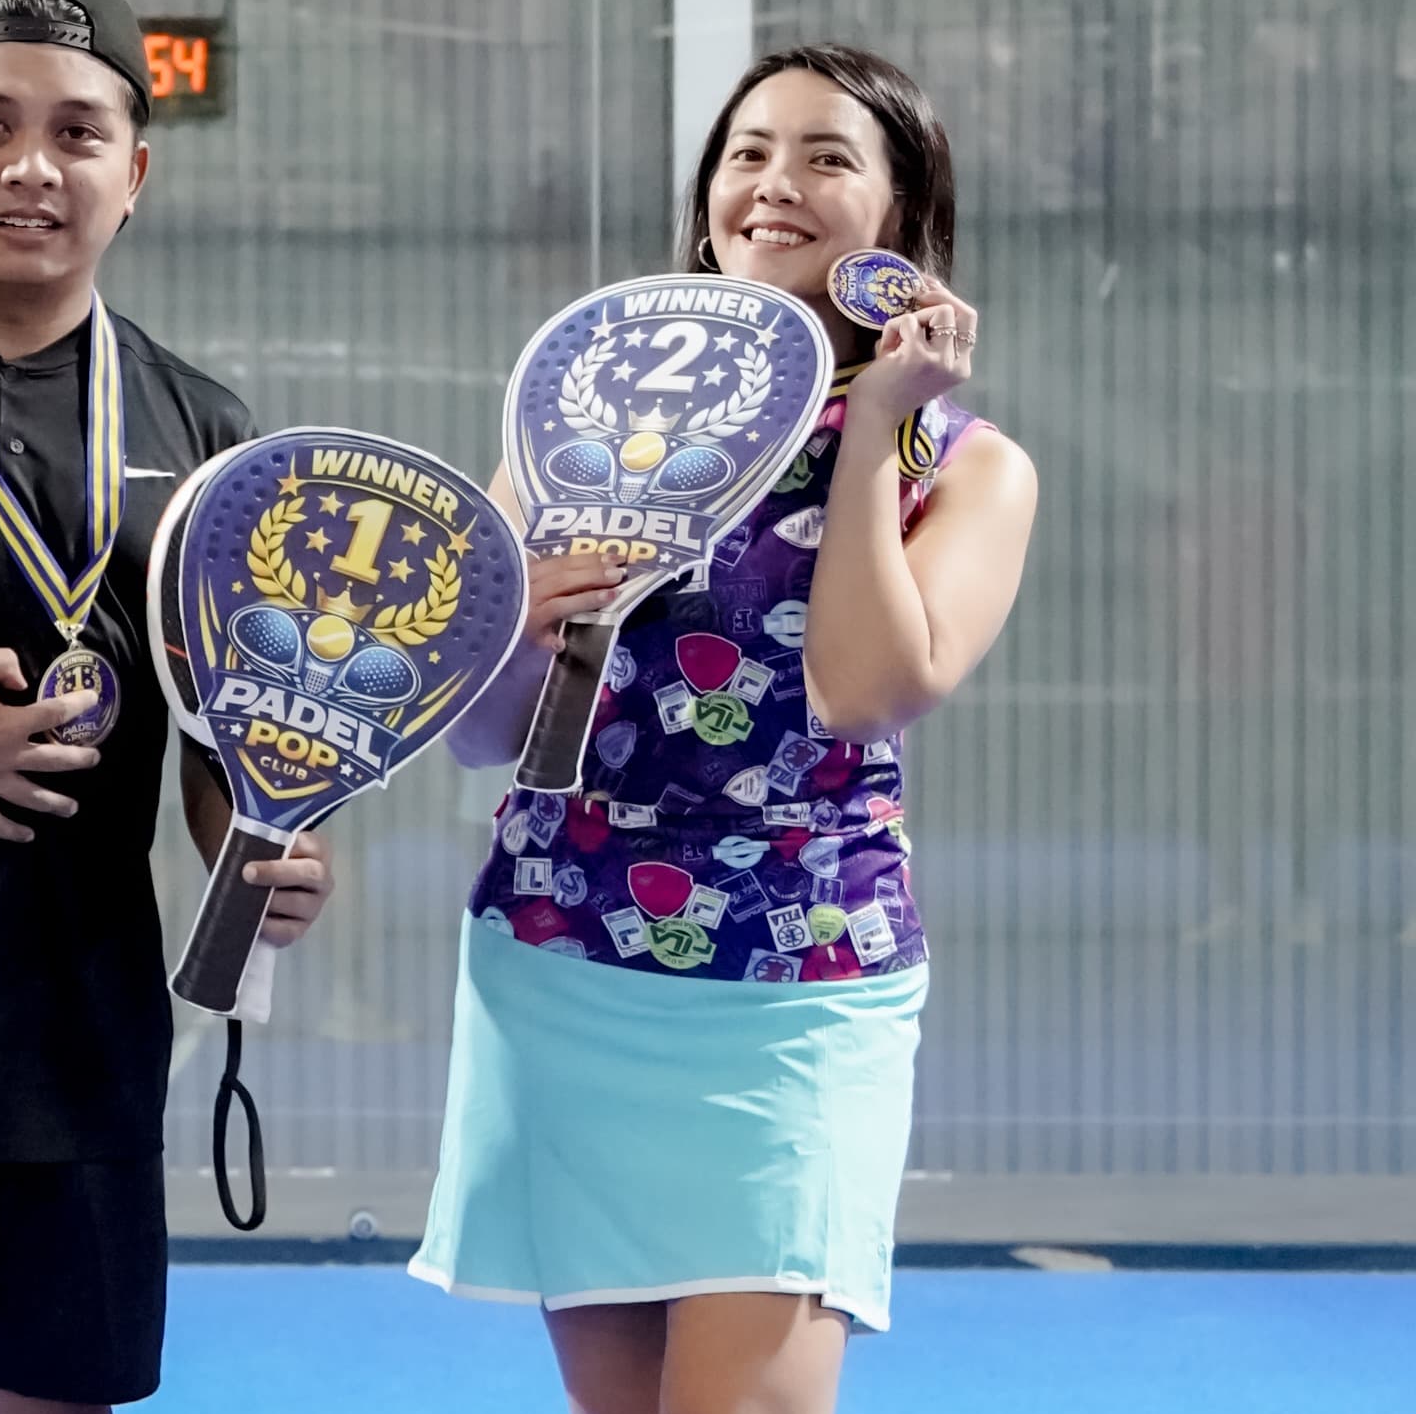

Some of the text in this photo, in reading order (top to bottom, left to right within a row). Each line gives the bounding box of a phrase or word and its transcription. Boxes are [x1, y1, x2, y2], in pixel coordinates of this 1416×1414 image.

[634, 321, 709, 393] 2
[329, 498, 395, 586] 1
[531, 507, 702, 552] PADEL
[212, 676, 383, 769] PADEL
[244, 720, 340, 768] POP
[259, 755, 308, 782] CLUB
